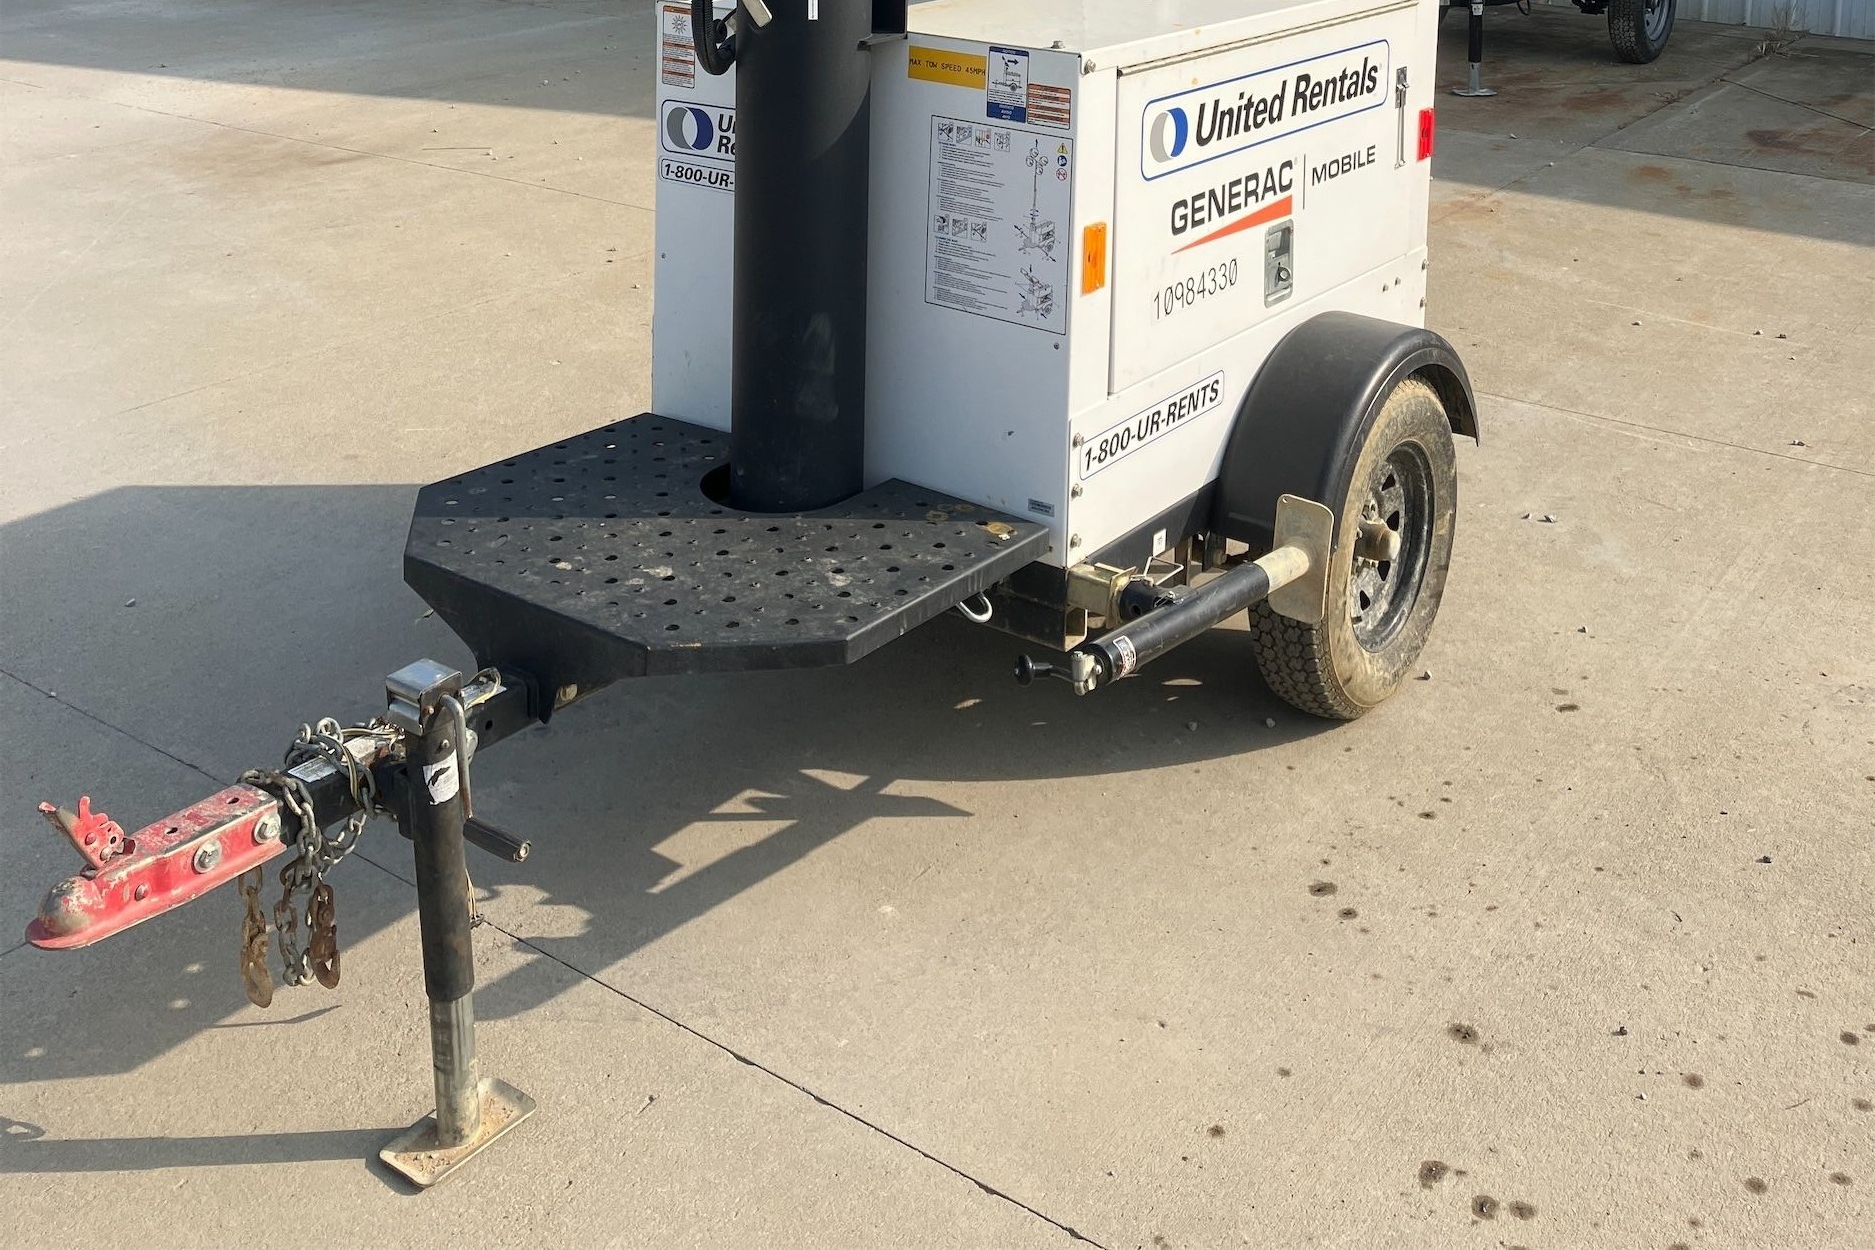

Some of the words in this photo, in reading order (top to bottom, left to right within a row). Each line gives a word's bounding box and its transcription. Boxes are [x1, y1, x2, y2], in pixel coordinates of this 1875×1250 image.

[909, 58, 922, 66] MAX
[925, 60, 938, 69] TOW
[940, 62, 962, 72] SPEED
[965, 66, 986, 76] 45MPH
[1195, 79, 1287, 147] United
[1291, 56, 1379, 117] Rentals
[1171, 159, 1294, 236] GENERAC
[1311, 144, 1376, 186] MOBILE
[1153, 258, 1238, 320] 10984330
[1085, 379, 1220, 471] 1-800-UR-RENTS
